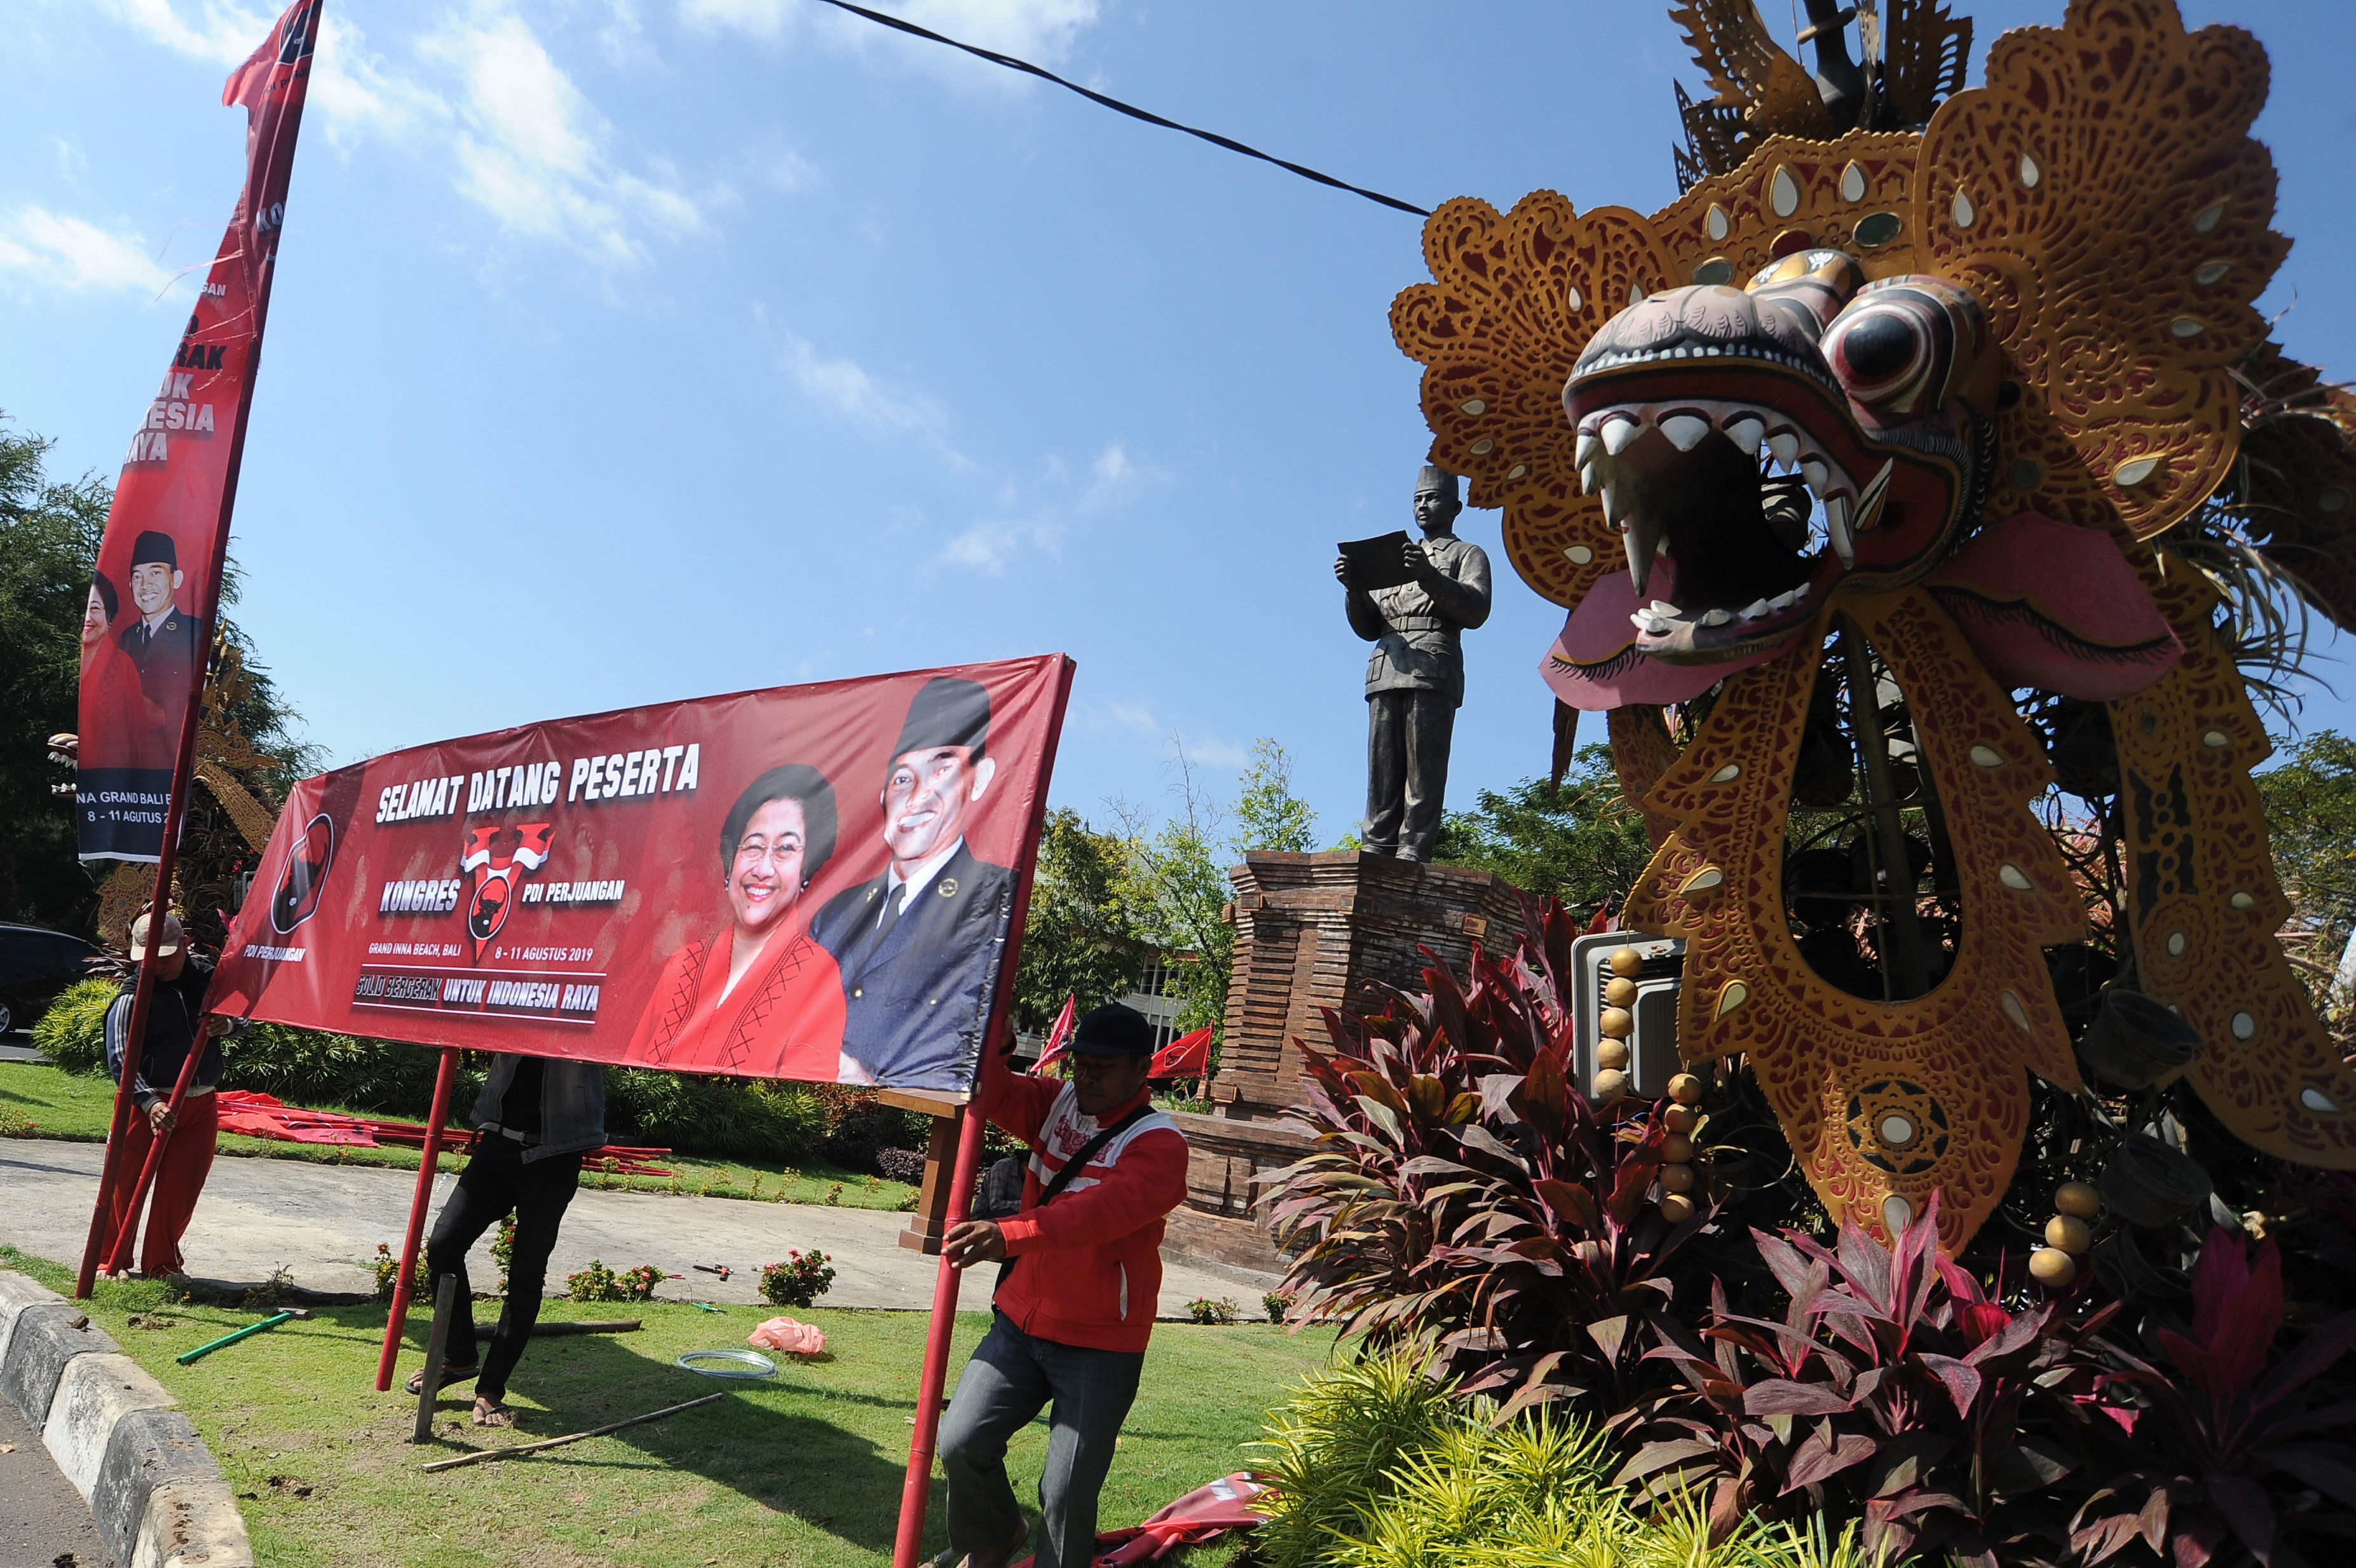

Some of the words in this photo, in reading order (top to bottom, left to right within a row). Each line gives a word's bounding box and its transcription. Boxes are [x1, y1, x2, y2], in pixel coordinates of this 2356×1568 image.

[255, 201, 286, 232] KO
[170, 343, 227, 369] RAK
[124, 432, 167, 465] AYA
[376, 775, 465, 823] SELAMAT
[466, 761, 561, 814] DATANG
[568, 742, 700, 802] PESERTA
[76, 793, 97, 804] NA
[100, 791, 139, 803] GRAND
[140, 793, 163, 805] BALI
[88, 811, 95, 822] 8
[109, 810, 120, 821] 11
[123, 810, 161, 824] AGUTUS
[379, 878, 461, 912] KONGRES
[522, 883, 543, 902] PDI
[545, 880, 625, 903] PERJUANGAN
[243, 944, 258, 958] PDI
[255, 945, 306, 962] PERJUANGAN
[369, 943, 392, 954] GRAND
[393, 943, 412, 955] INNA
[413, 943, 440, 957] BEACH,
[442, 944, 461, 957] BALI
[494, 946, 502, 959] 8
[510, 946, 520, 960] 11
[522, 947, 568, 961] AGUSTUS
[568, 948, 593, 961] 2019
[356, 974, 386, 997] SOLID
[384, 976, 443, 1000] BERGERAK
[443, 978, 487, 1004] UNTUK
[486, 981, 560, 1009] INDONESIA
[560, 984, 600, 1011] RAYA
